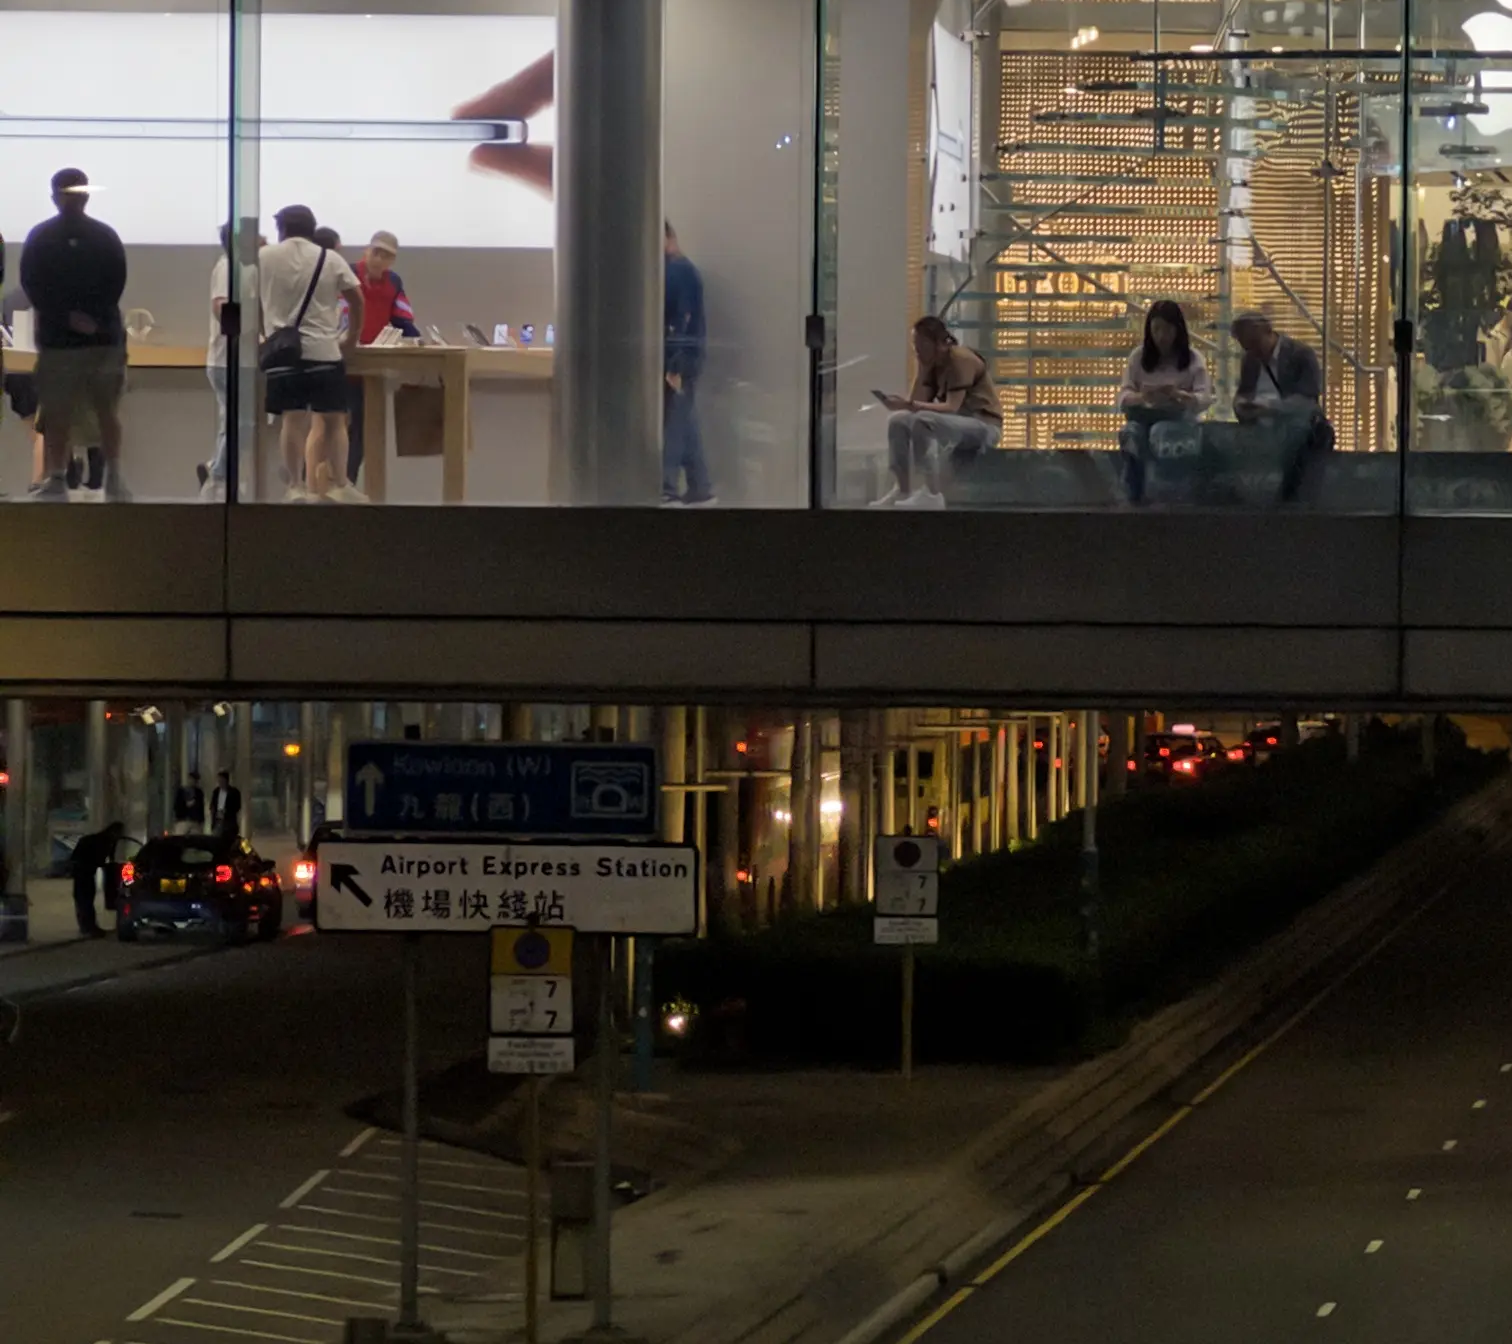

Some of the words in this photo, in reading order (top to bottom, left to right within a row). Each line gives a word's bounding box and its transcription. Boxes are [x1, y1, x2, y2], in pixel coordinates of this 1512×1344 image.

[392, 753, 496, 777] Kowloon
[506, 753, 551, 778] (W)
[381, 854, 468, 879] Airport
[483, 855, 581, 880] Express
[596, 857, 688, 878] Station
[383, 888, 566, 921] 機場快綫站
[544, 979, 558, 998] 7
[544, 1010, 558, 1029] 7
